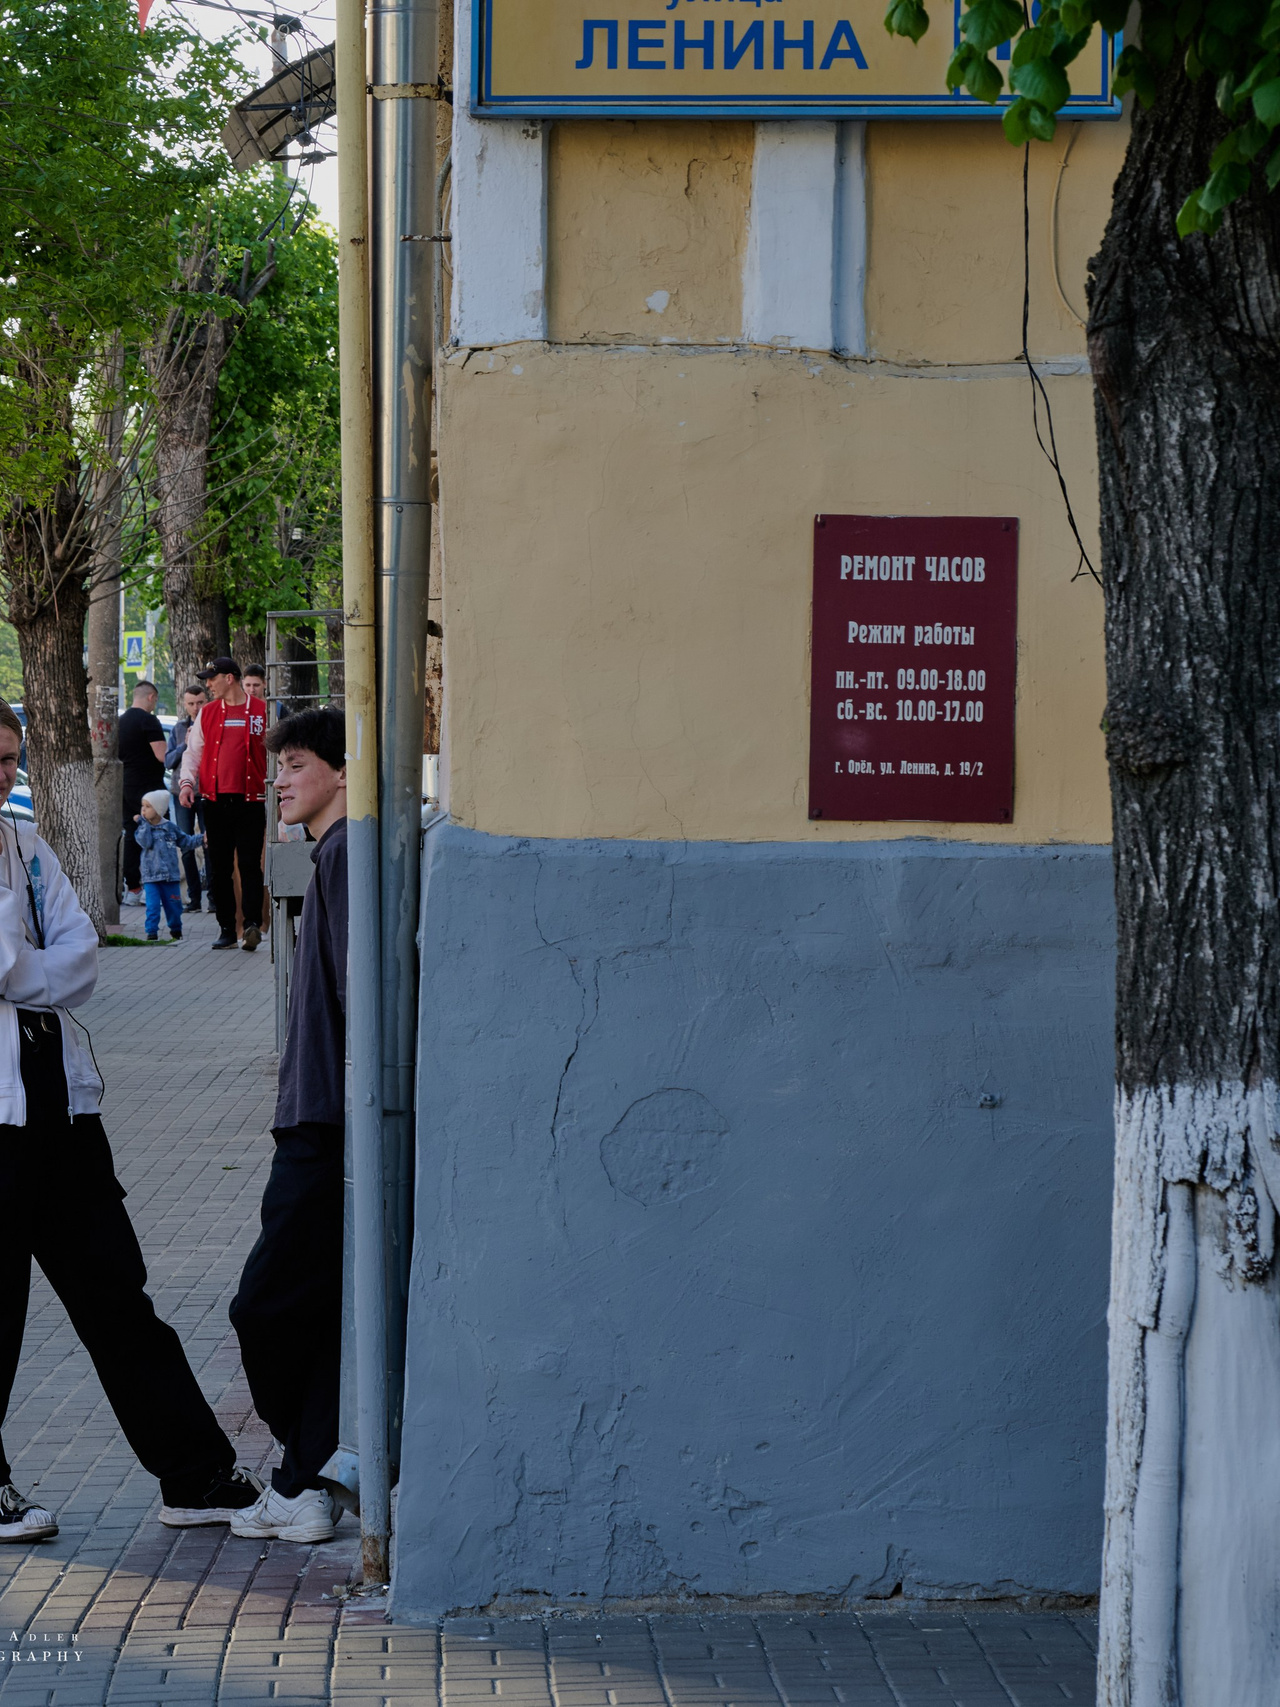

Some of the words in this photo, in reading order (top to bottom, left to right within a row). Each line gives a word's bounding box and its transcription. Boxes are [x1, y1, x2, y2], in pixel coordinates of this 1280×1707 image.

[575, 19, 869, 71] ЛЕНИНА
[840, 555, 916, 580] РЕМОНТ
[925, 556, 986, 582] ЧАСОВ
[848, 621, 905, 644] Режим
[914, 623, 975, 647] работы
[836, 671, 889, 689] пн.-пт.
[897, 669, 986, 691] 09.00-18.00
[837, 699, 888, 720] сб.-вс.
[896, 700, 984, 722] 10.00-17.00
[835, 761, 843, 773] г.
[848, 760, 875, 775] Орёл,
[880, 762, 895, 775] ул.
[900, 761, 939, 776] Ленина,
[944, 763, 954, 775] д.
[959, 762, 983, 776] 19/2
